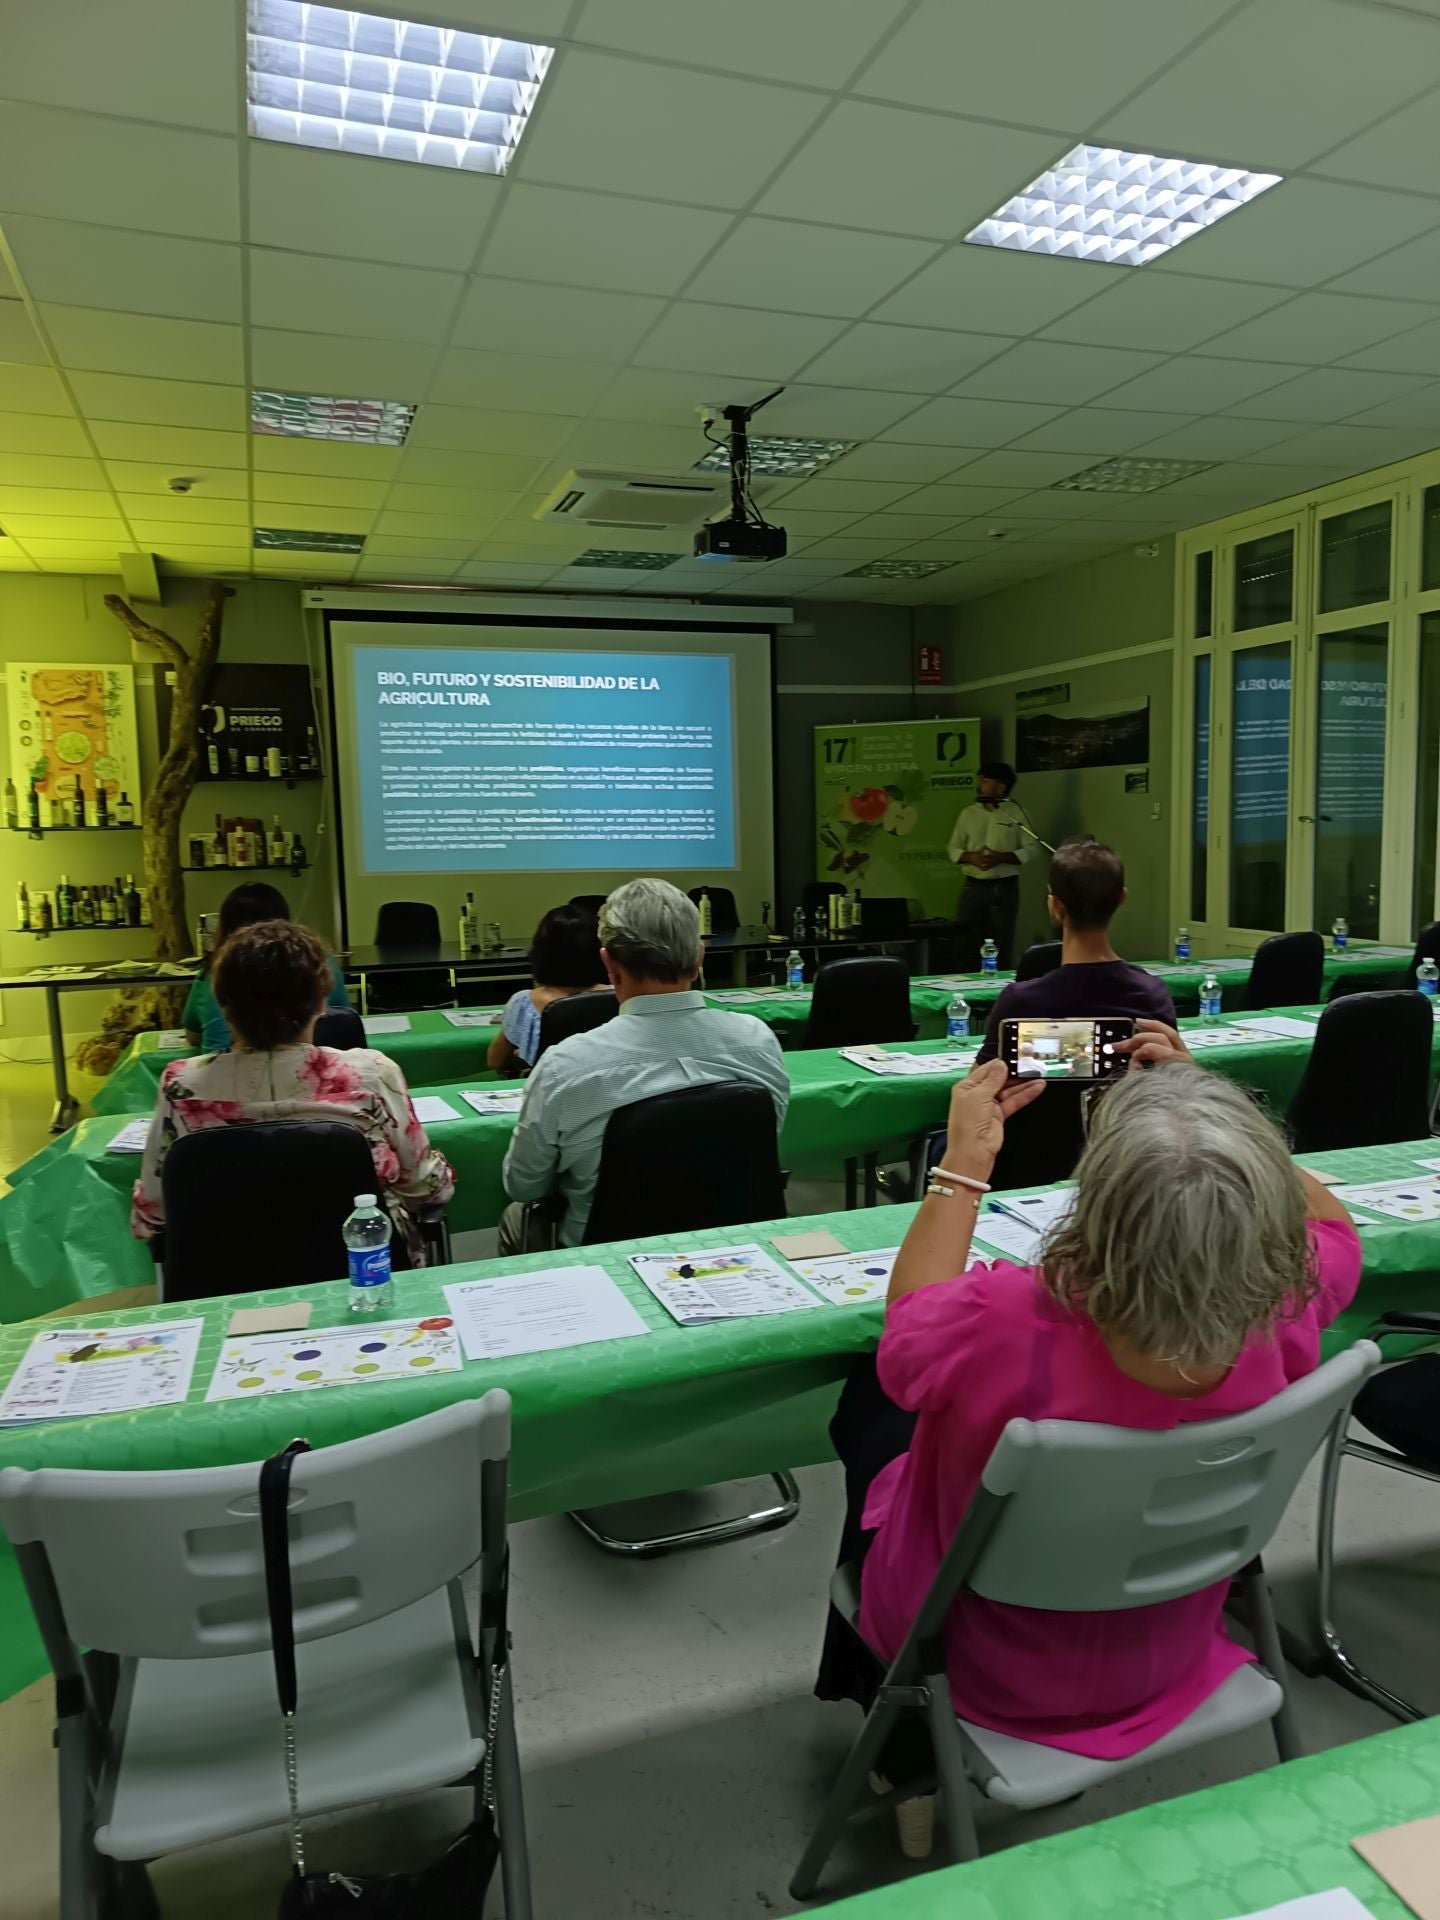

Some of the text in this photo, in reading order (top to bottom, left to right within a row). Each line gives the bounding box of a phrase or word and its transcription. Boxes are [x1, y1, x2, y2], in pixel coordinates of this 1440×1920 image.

[377, 672, 660, 690] BIO, FUTURO Y SOSTENIBILIDAD DE LA
[378, 691, 491, 706] AGRICULTURA
[230, 715, 282, 726] PRIEGO
[931, 776, 973, 787] PRIEGO
